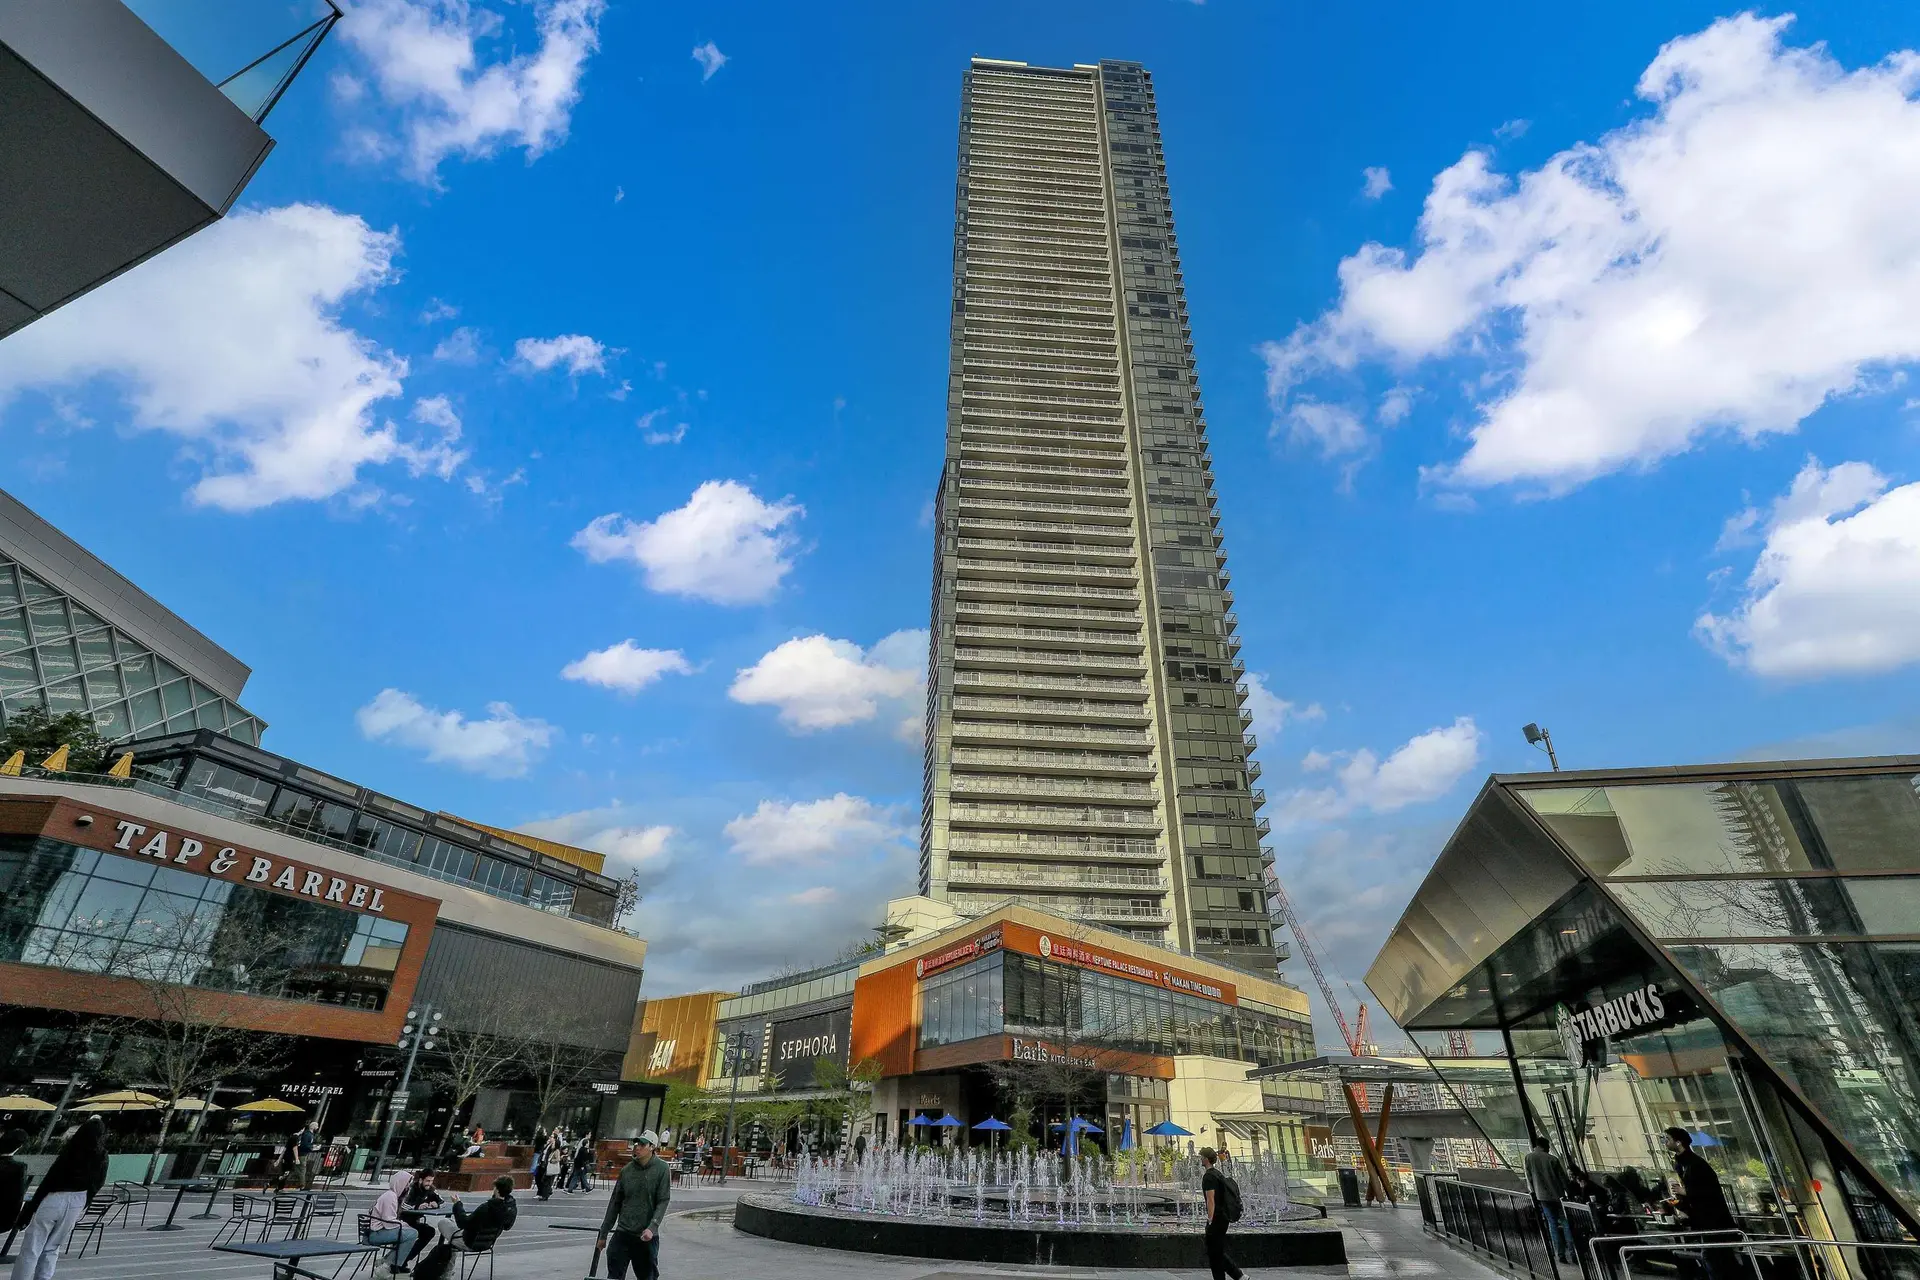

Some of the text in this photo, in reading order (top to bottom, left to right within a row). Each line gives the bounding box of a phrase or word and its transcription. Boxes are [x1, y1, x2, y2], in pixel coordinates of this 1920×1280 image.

[114, 820, 385, 912] TAP & BARREL
[1112, 960, 1128, 973] PALACE
[1128, 963, 1154, 979] RESTAURANT
[1171, 976, 1190, 990] MAKAN
[1190, 981, 1202, 993] TIME
[1570, 984, 1665, 1044] STARBUCKS
[648, 1039, 677, 1071] H&M
[780, 1033, 837, 1061] SEPHORA
[1013, 1037, 1048, 1062] Earls
[280, 1084, 344, 1095] TAP & BARREL
[1311, 1137, 1335, 1159] Earls
